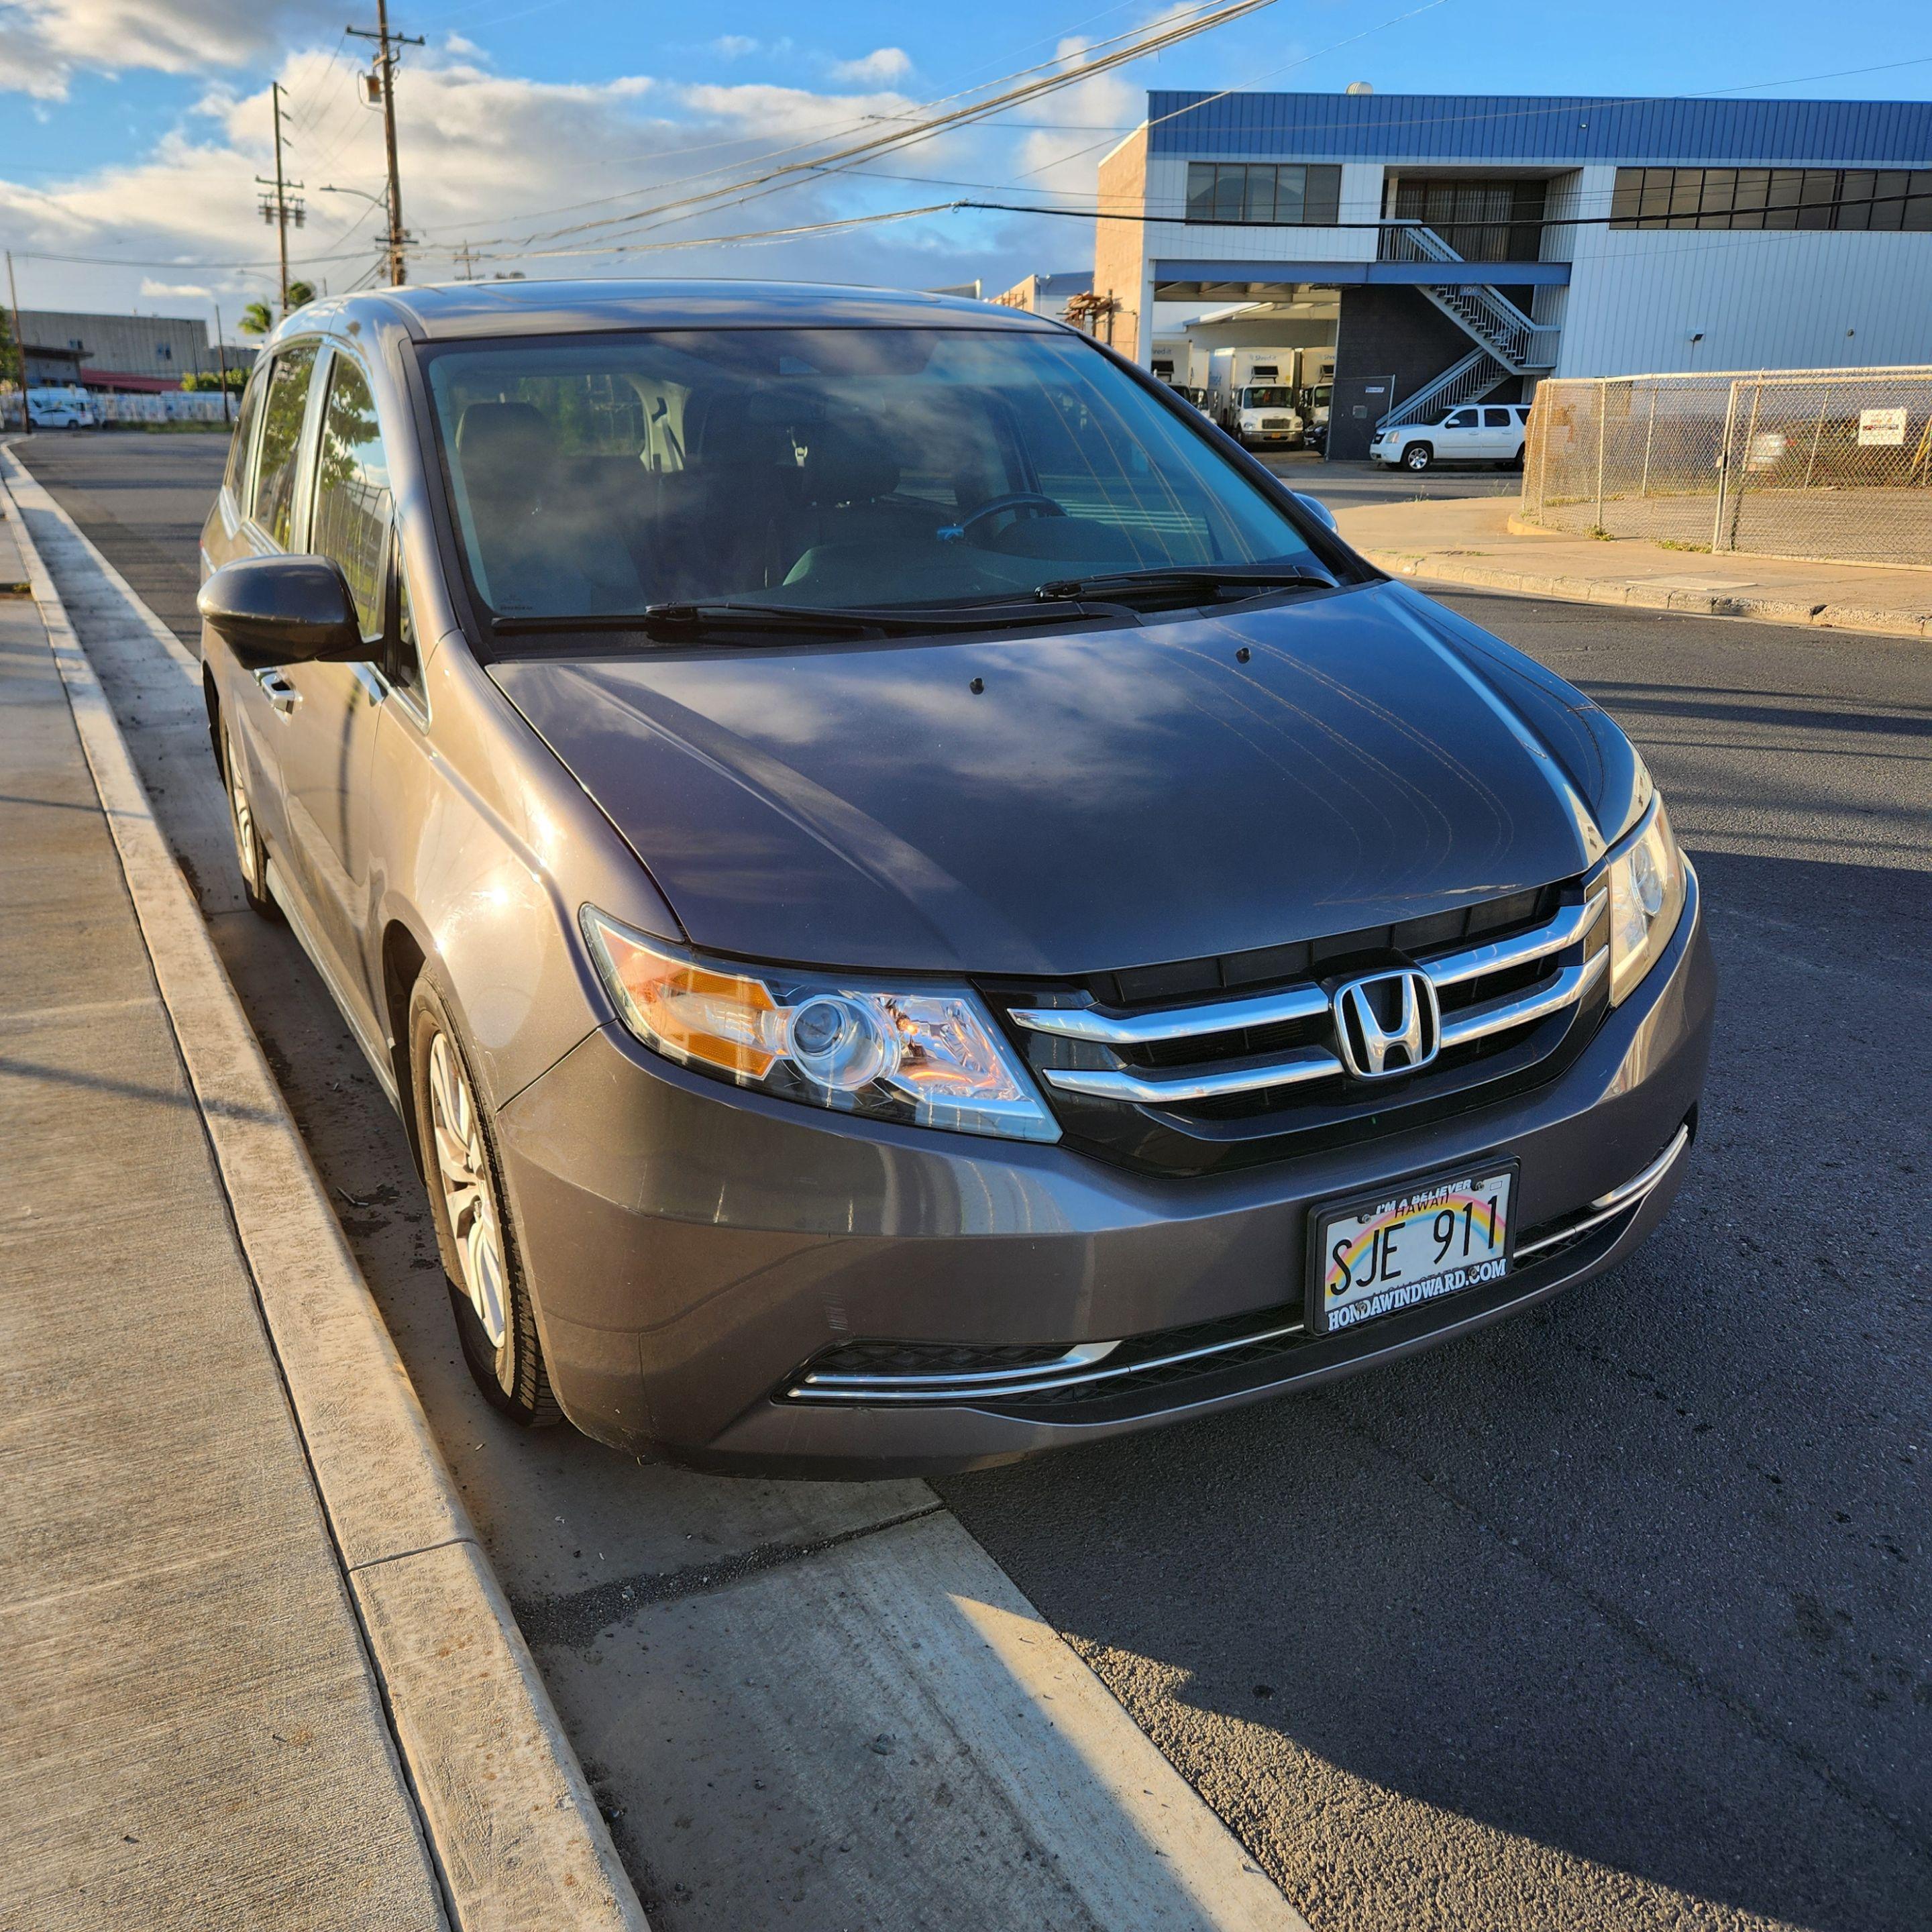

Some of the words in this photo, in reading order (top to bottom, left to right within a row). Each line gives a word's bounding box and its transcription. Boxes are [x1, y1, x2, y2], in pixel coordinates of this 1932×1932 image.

[1376, 1200, 1396, 1215] I'M
[1399, 1198, 1408, 1209] A
[1411, 1179, 1472, 1205] BELIEVER
[1330, 1222, 1405, 1295] SJE
[1434, 1195, 1498, 1265] 911
[1328, 1258, 1507, 1332] HONDAWINDWARD.COM
